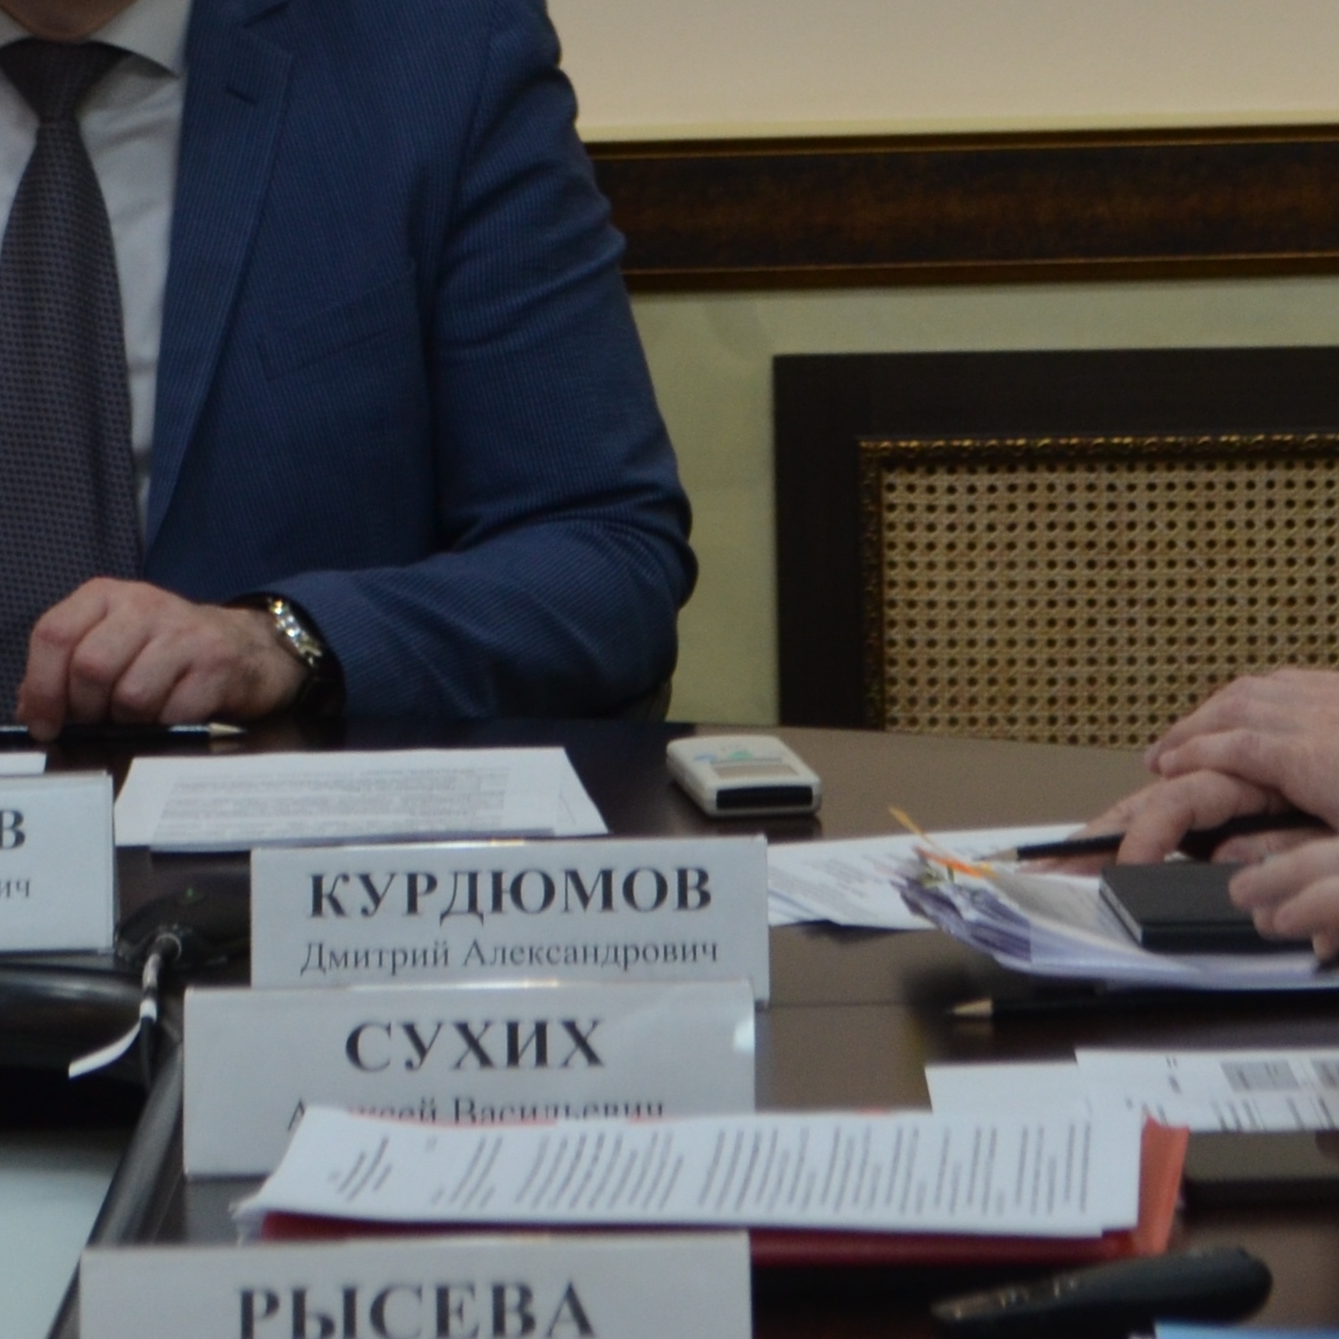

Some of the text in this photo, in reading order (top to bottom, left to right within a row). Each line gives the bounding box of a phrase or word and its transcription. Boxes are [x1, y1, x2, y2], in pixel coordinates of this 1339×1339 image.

[308, 866, 713, 927] КУРДЮМОВ
[300, 938, 719, 976] Дмитрий Александрович
[345, 1017, 606, 1073] СУХИХ
[238, 1280, 597, 1339] РЫСЕВА
